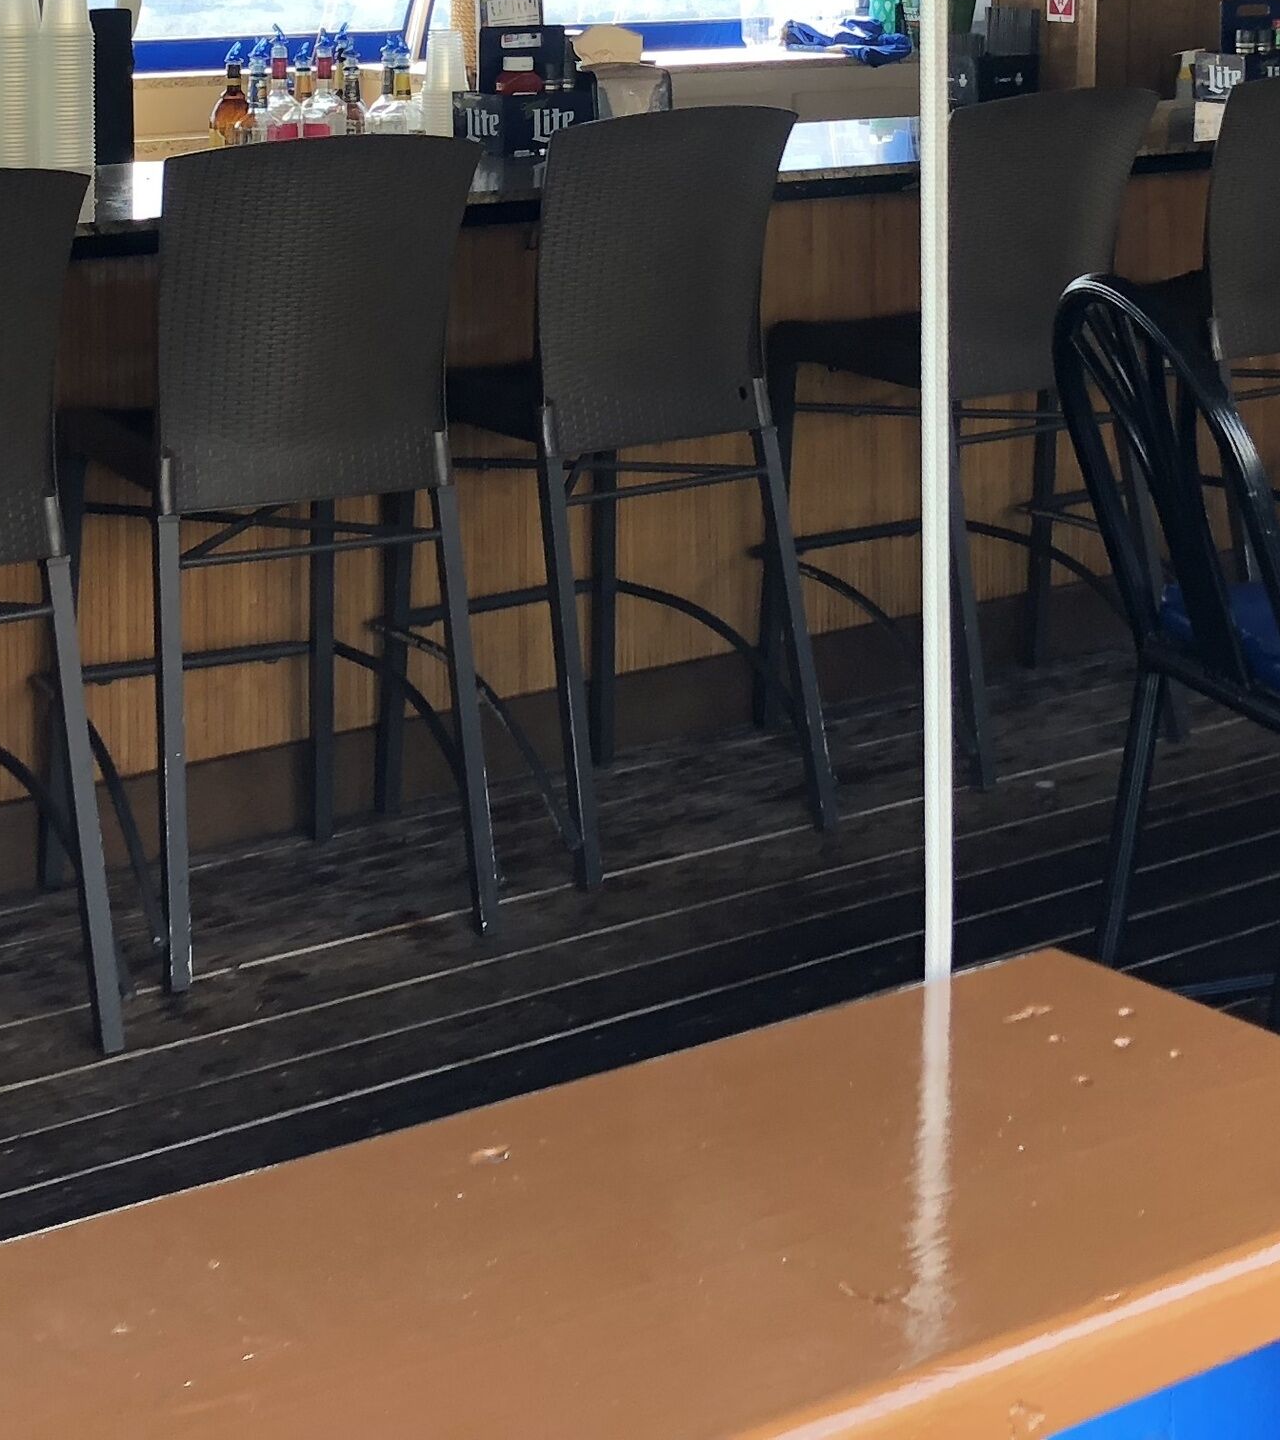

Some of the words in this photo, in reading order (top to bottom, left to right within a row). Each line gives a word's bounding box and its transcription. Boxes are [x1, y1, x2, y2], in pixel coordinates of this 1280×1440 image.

[1207, 65, 1242, 94] Lite
[466, 107, 500, 143] Lite
[532, 108, 575, 143] Lite
